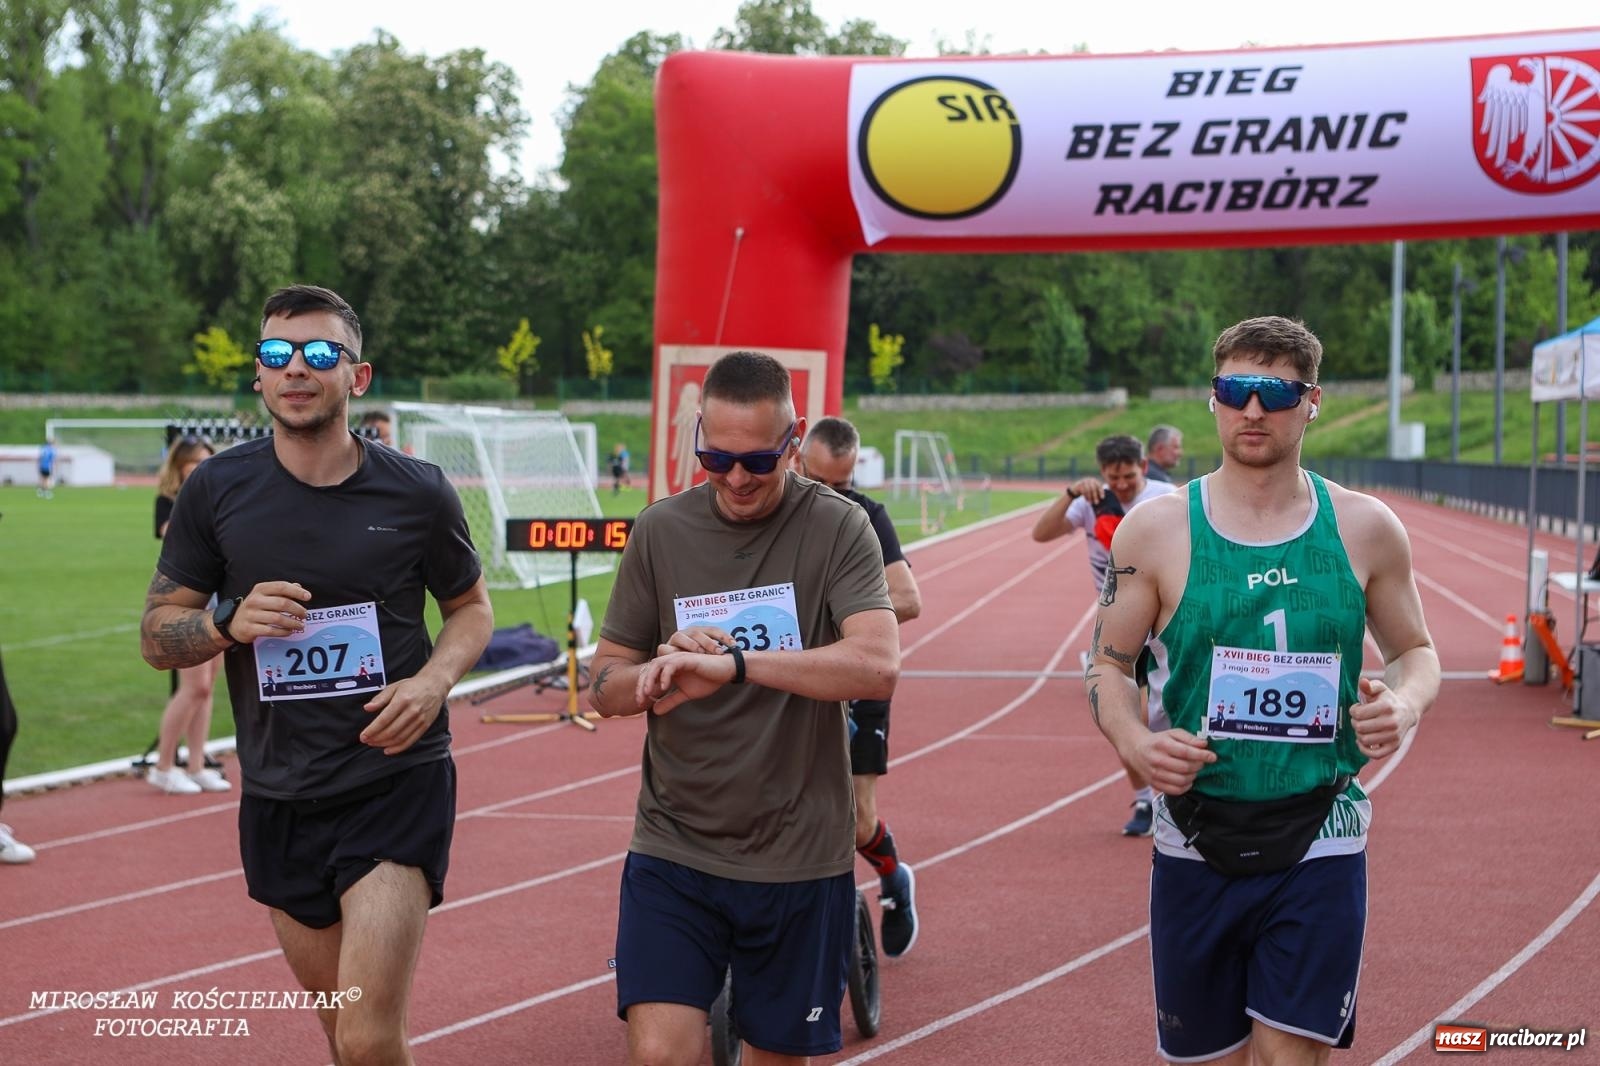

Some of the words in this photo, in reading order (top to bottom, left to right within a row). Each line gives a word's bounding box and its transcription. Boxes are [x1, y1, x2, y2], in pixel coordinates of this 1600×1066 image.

[1165, 66, 1303, 98] BIEG
[936, 93, 1017, 122] SIR
[1065, 121, 1181, 160] BEZ
[1190, 111, 1408, 156] GRANIC
[1094, 167, 1380, 216] RACIBÓRZ
[1247, 567, 1298, 590] POL
[684, 600, 703, 608] XVII
[704, 596, 727, 606] BIEG
[728, 592, 746, 602] BEZ
[748, 587, 785, 600] GRANIC
[305, 612, 324, 621] BEZ
[327, 606, 366, 620] GRANIC
[692, 612, 710, 620] maja
[711, 608, 729, 616] 2025
[1263, 608, 1288, 652] 1
[285, 643, 349, 676] 207
[1224, 650, 1244, 659] XVII
[1246, 653, 1271, 662] BIEG
[1274, 656, 1293, 664] BEZ
[1296, 656, 1332, 665] GRANIC
[1228, 665, 1249, 673] maja
[1250, 666, 1270, 674] 2025
[1243, 688, 1307, 718] 189
